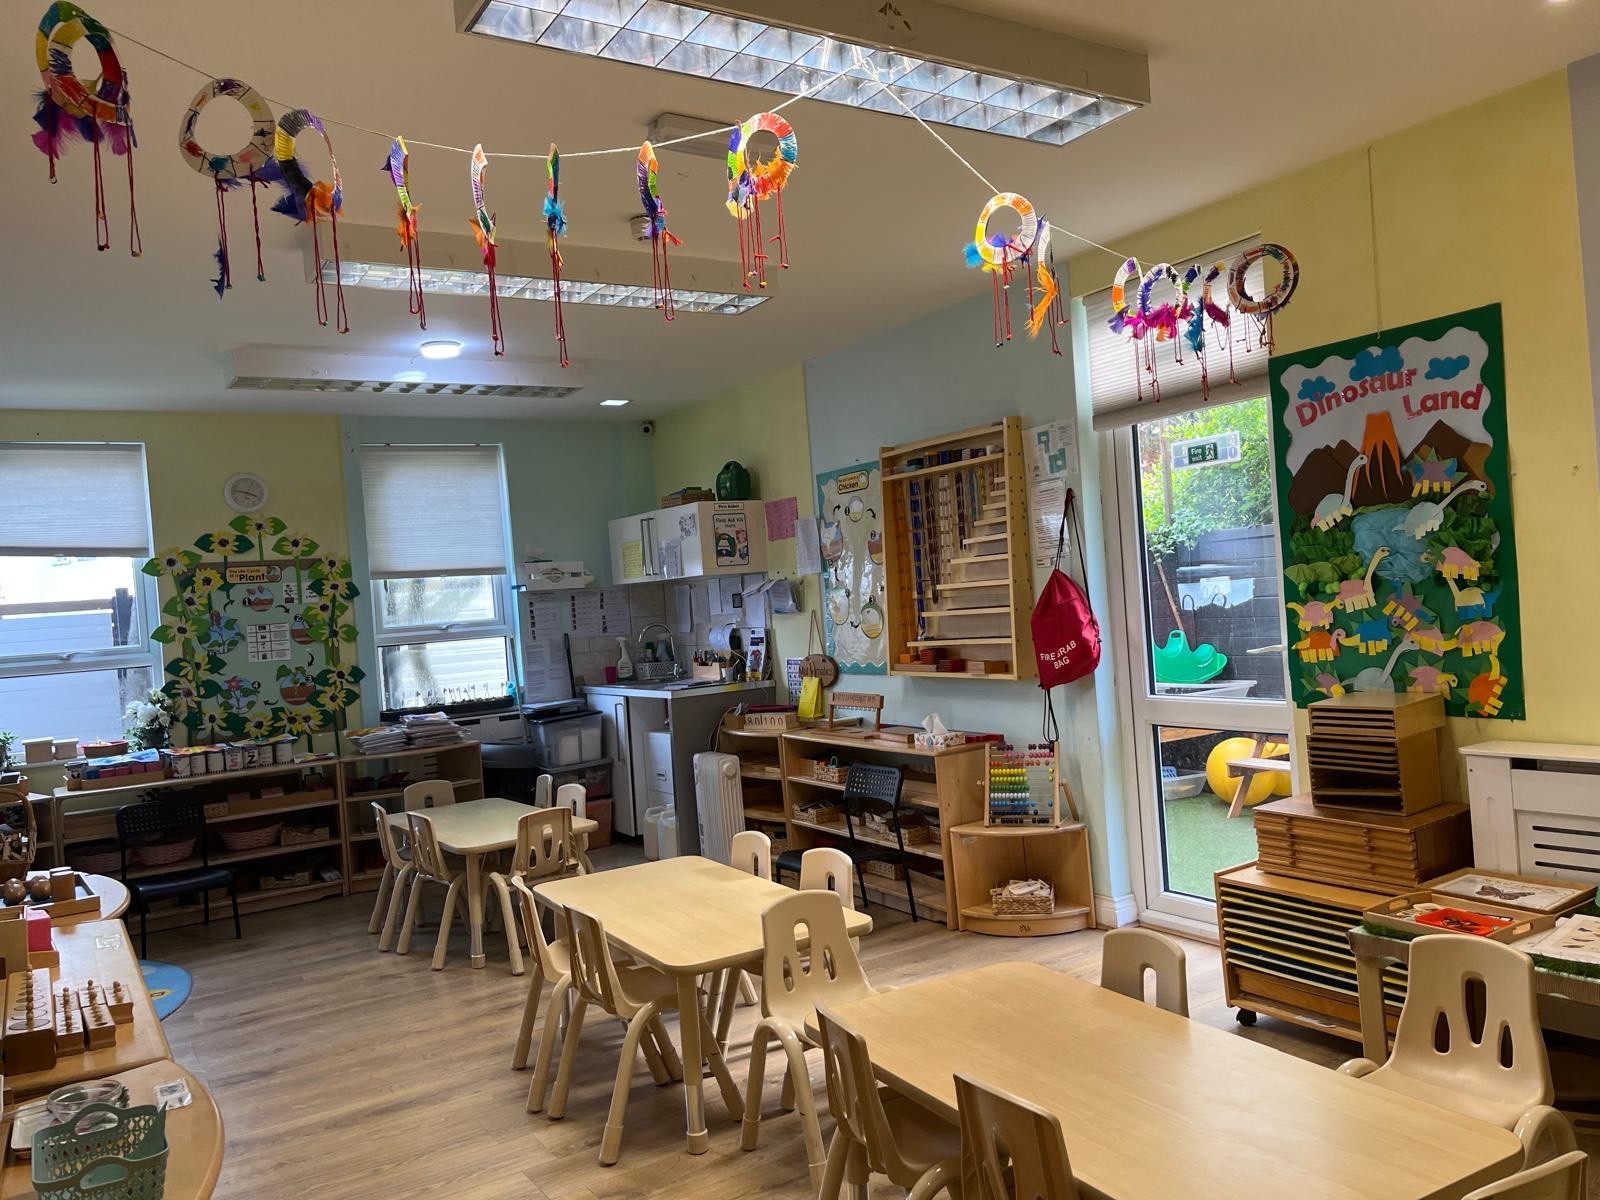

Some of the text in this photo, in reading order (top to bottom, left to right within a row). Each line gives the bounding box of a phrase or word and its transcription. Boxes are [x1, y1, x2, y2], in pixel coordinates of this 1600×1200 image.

[1295, 368, 1417, 427] Dinosaur
[1402, 383, 1484, 420] Land
[1191, 447, 1202, 455] Fire
[838, 482, 859, 491] Chicken
[239, 573, 265, 581] Plant
[1040, 652, 1056, 661] FIRE
[1053, 656, 1070, 670] BAG
